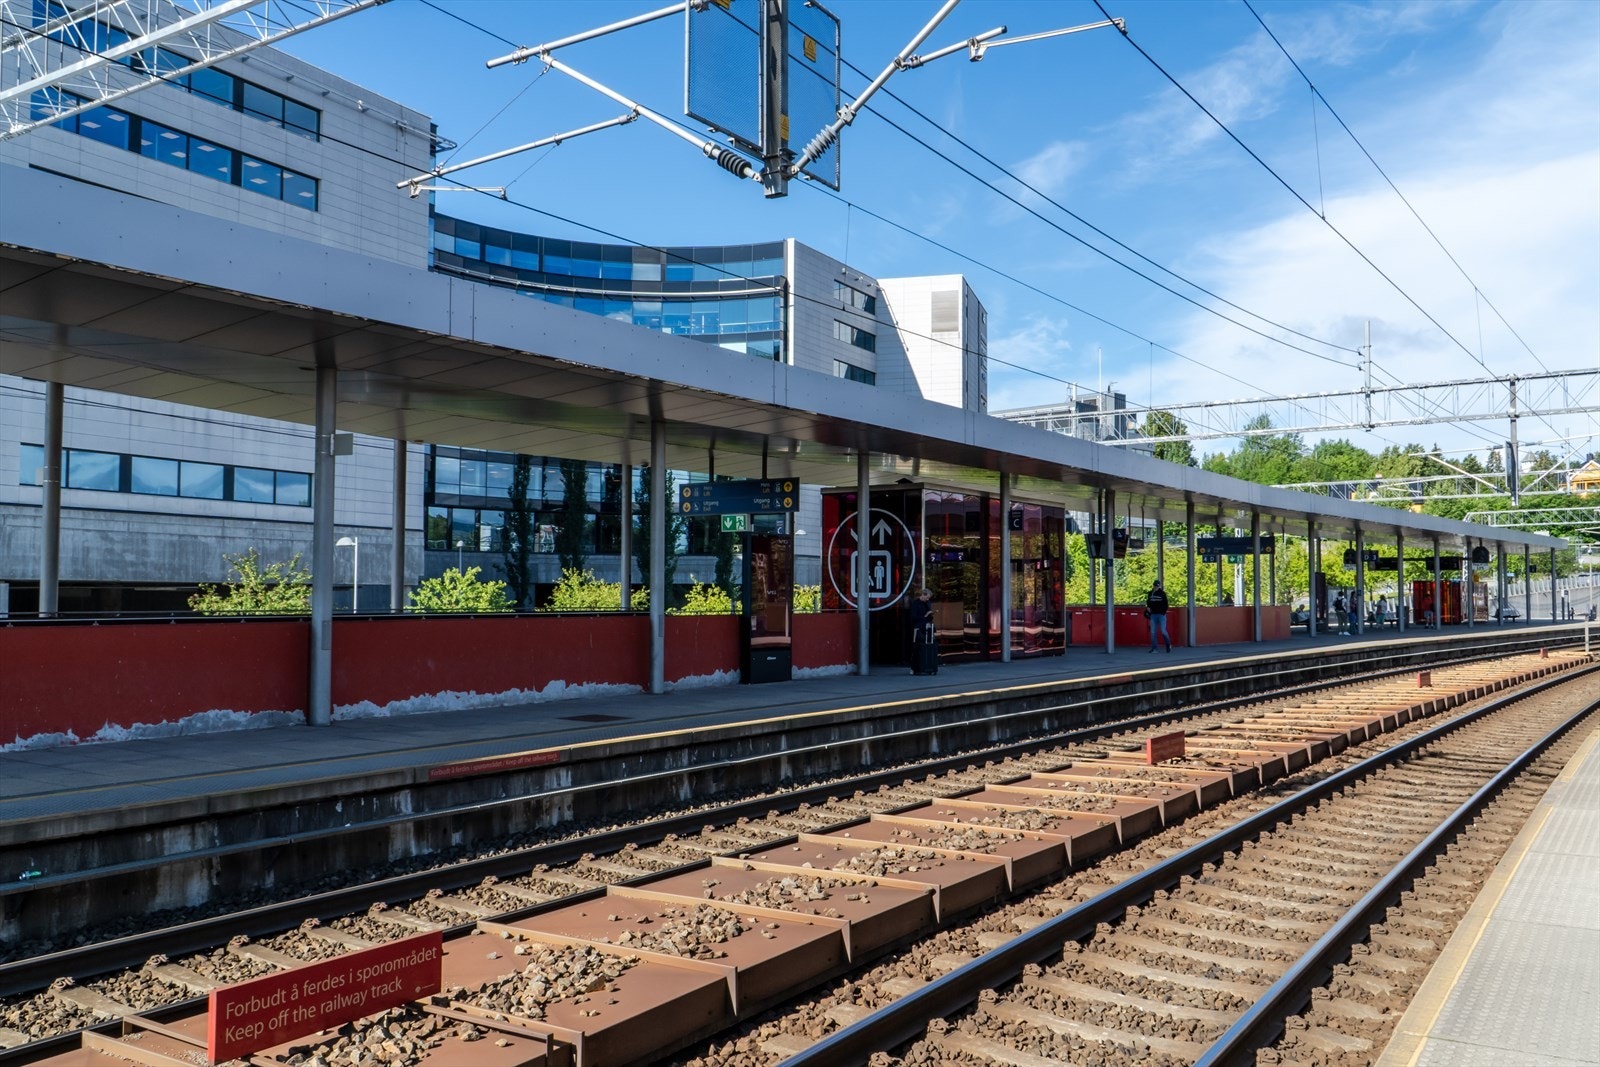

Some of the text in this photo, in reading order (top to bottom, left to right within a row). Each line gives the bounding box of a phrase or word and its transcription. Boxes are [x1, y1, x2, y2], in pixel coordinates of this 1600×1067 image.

[225, 975, 402, 1045] Keep off the railway track
[226, 946, 438, 1020] Forbudt å ferdes i sporområdet
